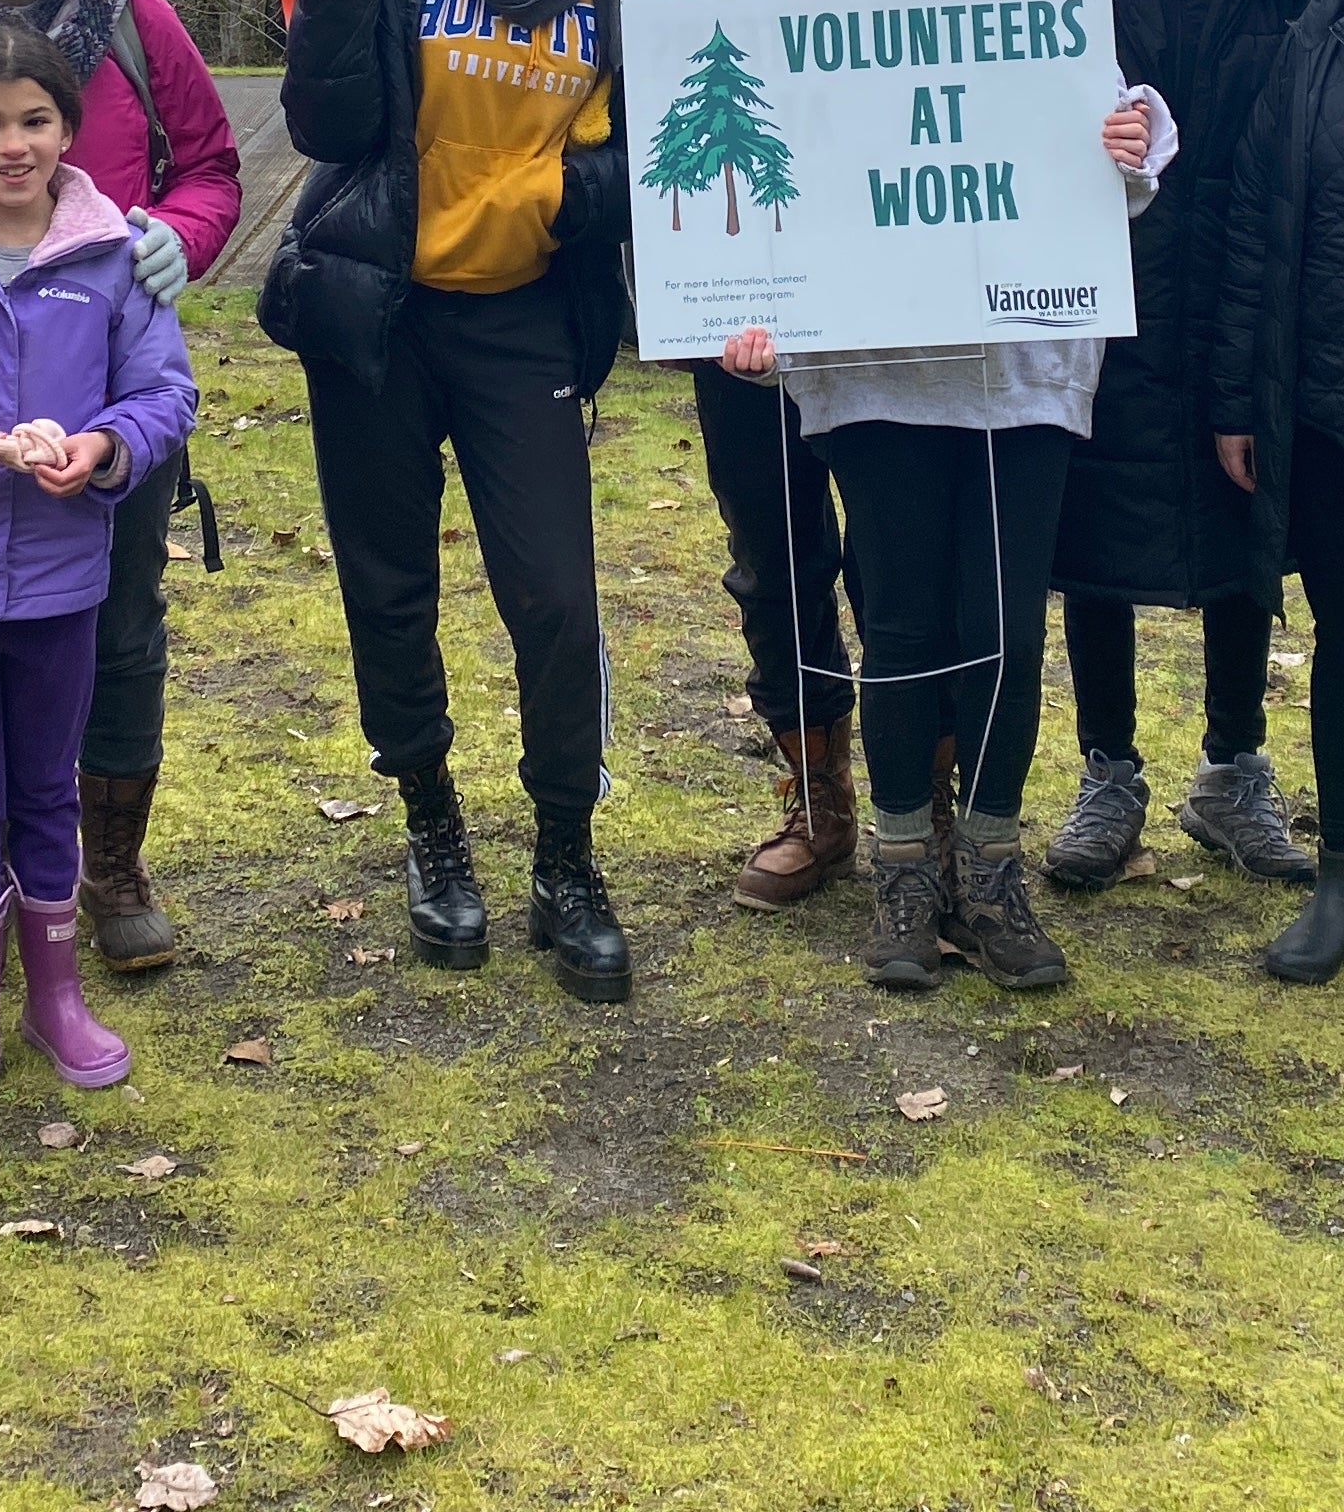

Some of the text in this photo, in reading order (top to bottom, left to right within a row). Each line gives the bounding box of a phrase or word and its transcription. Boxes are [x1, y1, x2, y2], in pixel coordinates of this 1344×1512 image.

[910, 84, 966, 145] AT
[868, 161, 1019, 227] WORK
[665, 274, 807, 290] For more information, contact
[48, 288, 90, 304] Columbia
[683, 291, 795, 303] the volunteer program:
[985, 284, 1098, 312] Vancouver
[1039, 308, 1098, 317] WASHINGTON
[702, 314, 778, 328] 360-487-8344
